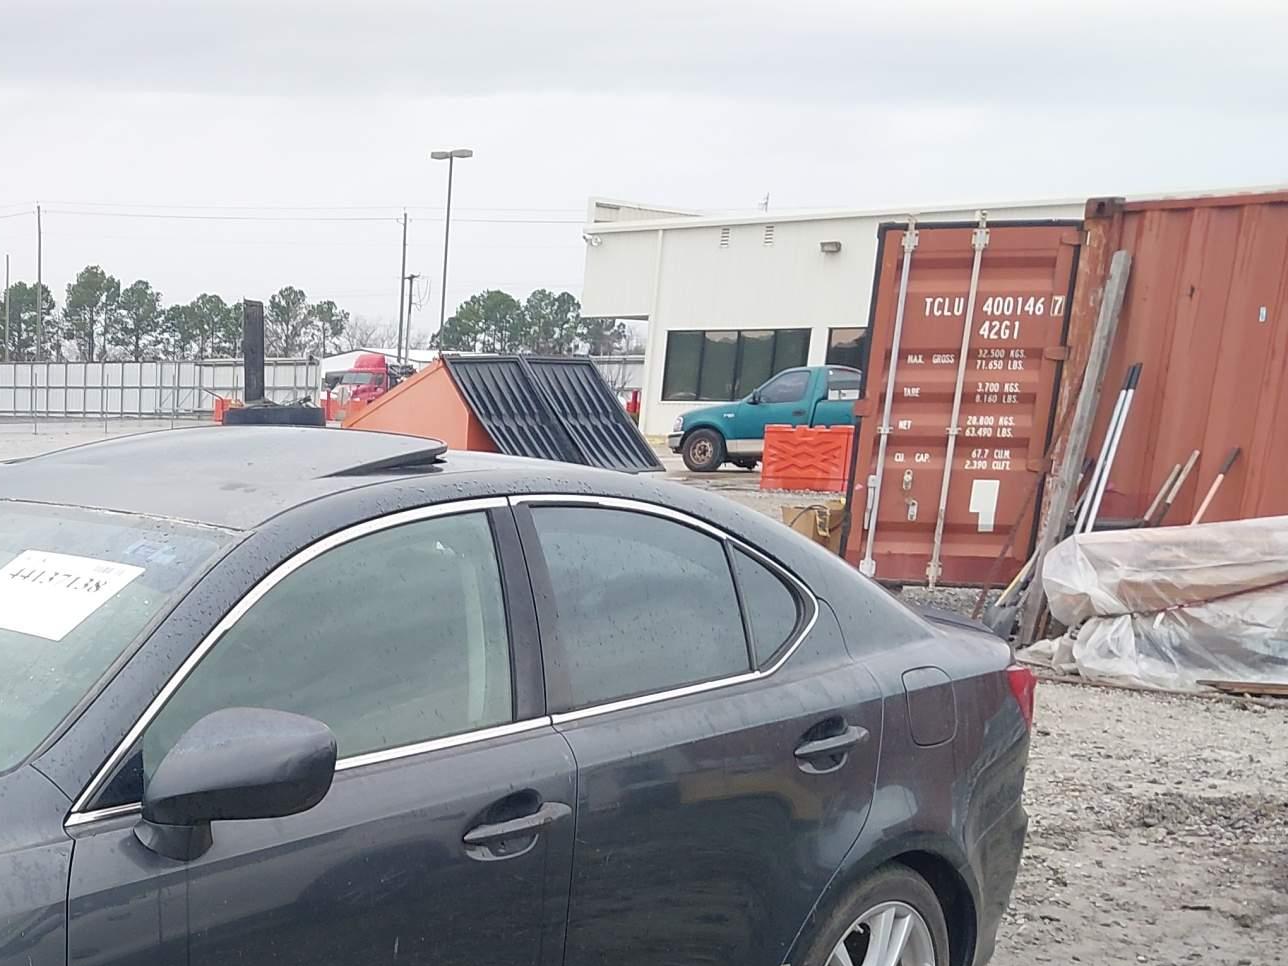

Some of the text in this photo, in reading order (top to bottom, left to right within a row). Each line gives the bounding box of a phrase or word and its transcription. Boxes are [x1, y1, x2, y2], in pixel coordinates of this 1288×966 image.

[924, 297, 964, 316] TCLU
[982, 296, 1045, 316] 400146
[979, 320, 1020, 340] 42G1
[932, 353, 955, 365] GROSS
[976, 359, 1024, 371] 71.650 LBS.
[903, 386, 921, 397] TARE
[976, 382, 1000, 393] 3.700
[898, 419, 912, 430] NET
[965, 426, 1013, 438] 63.490 LBS.
[971, 448, 989, 459] 67.7
[964, 459, 988, 470] 2.390
